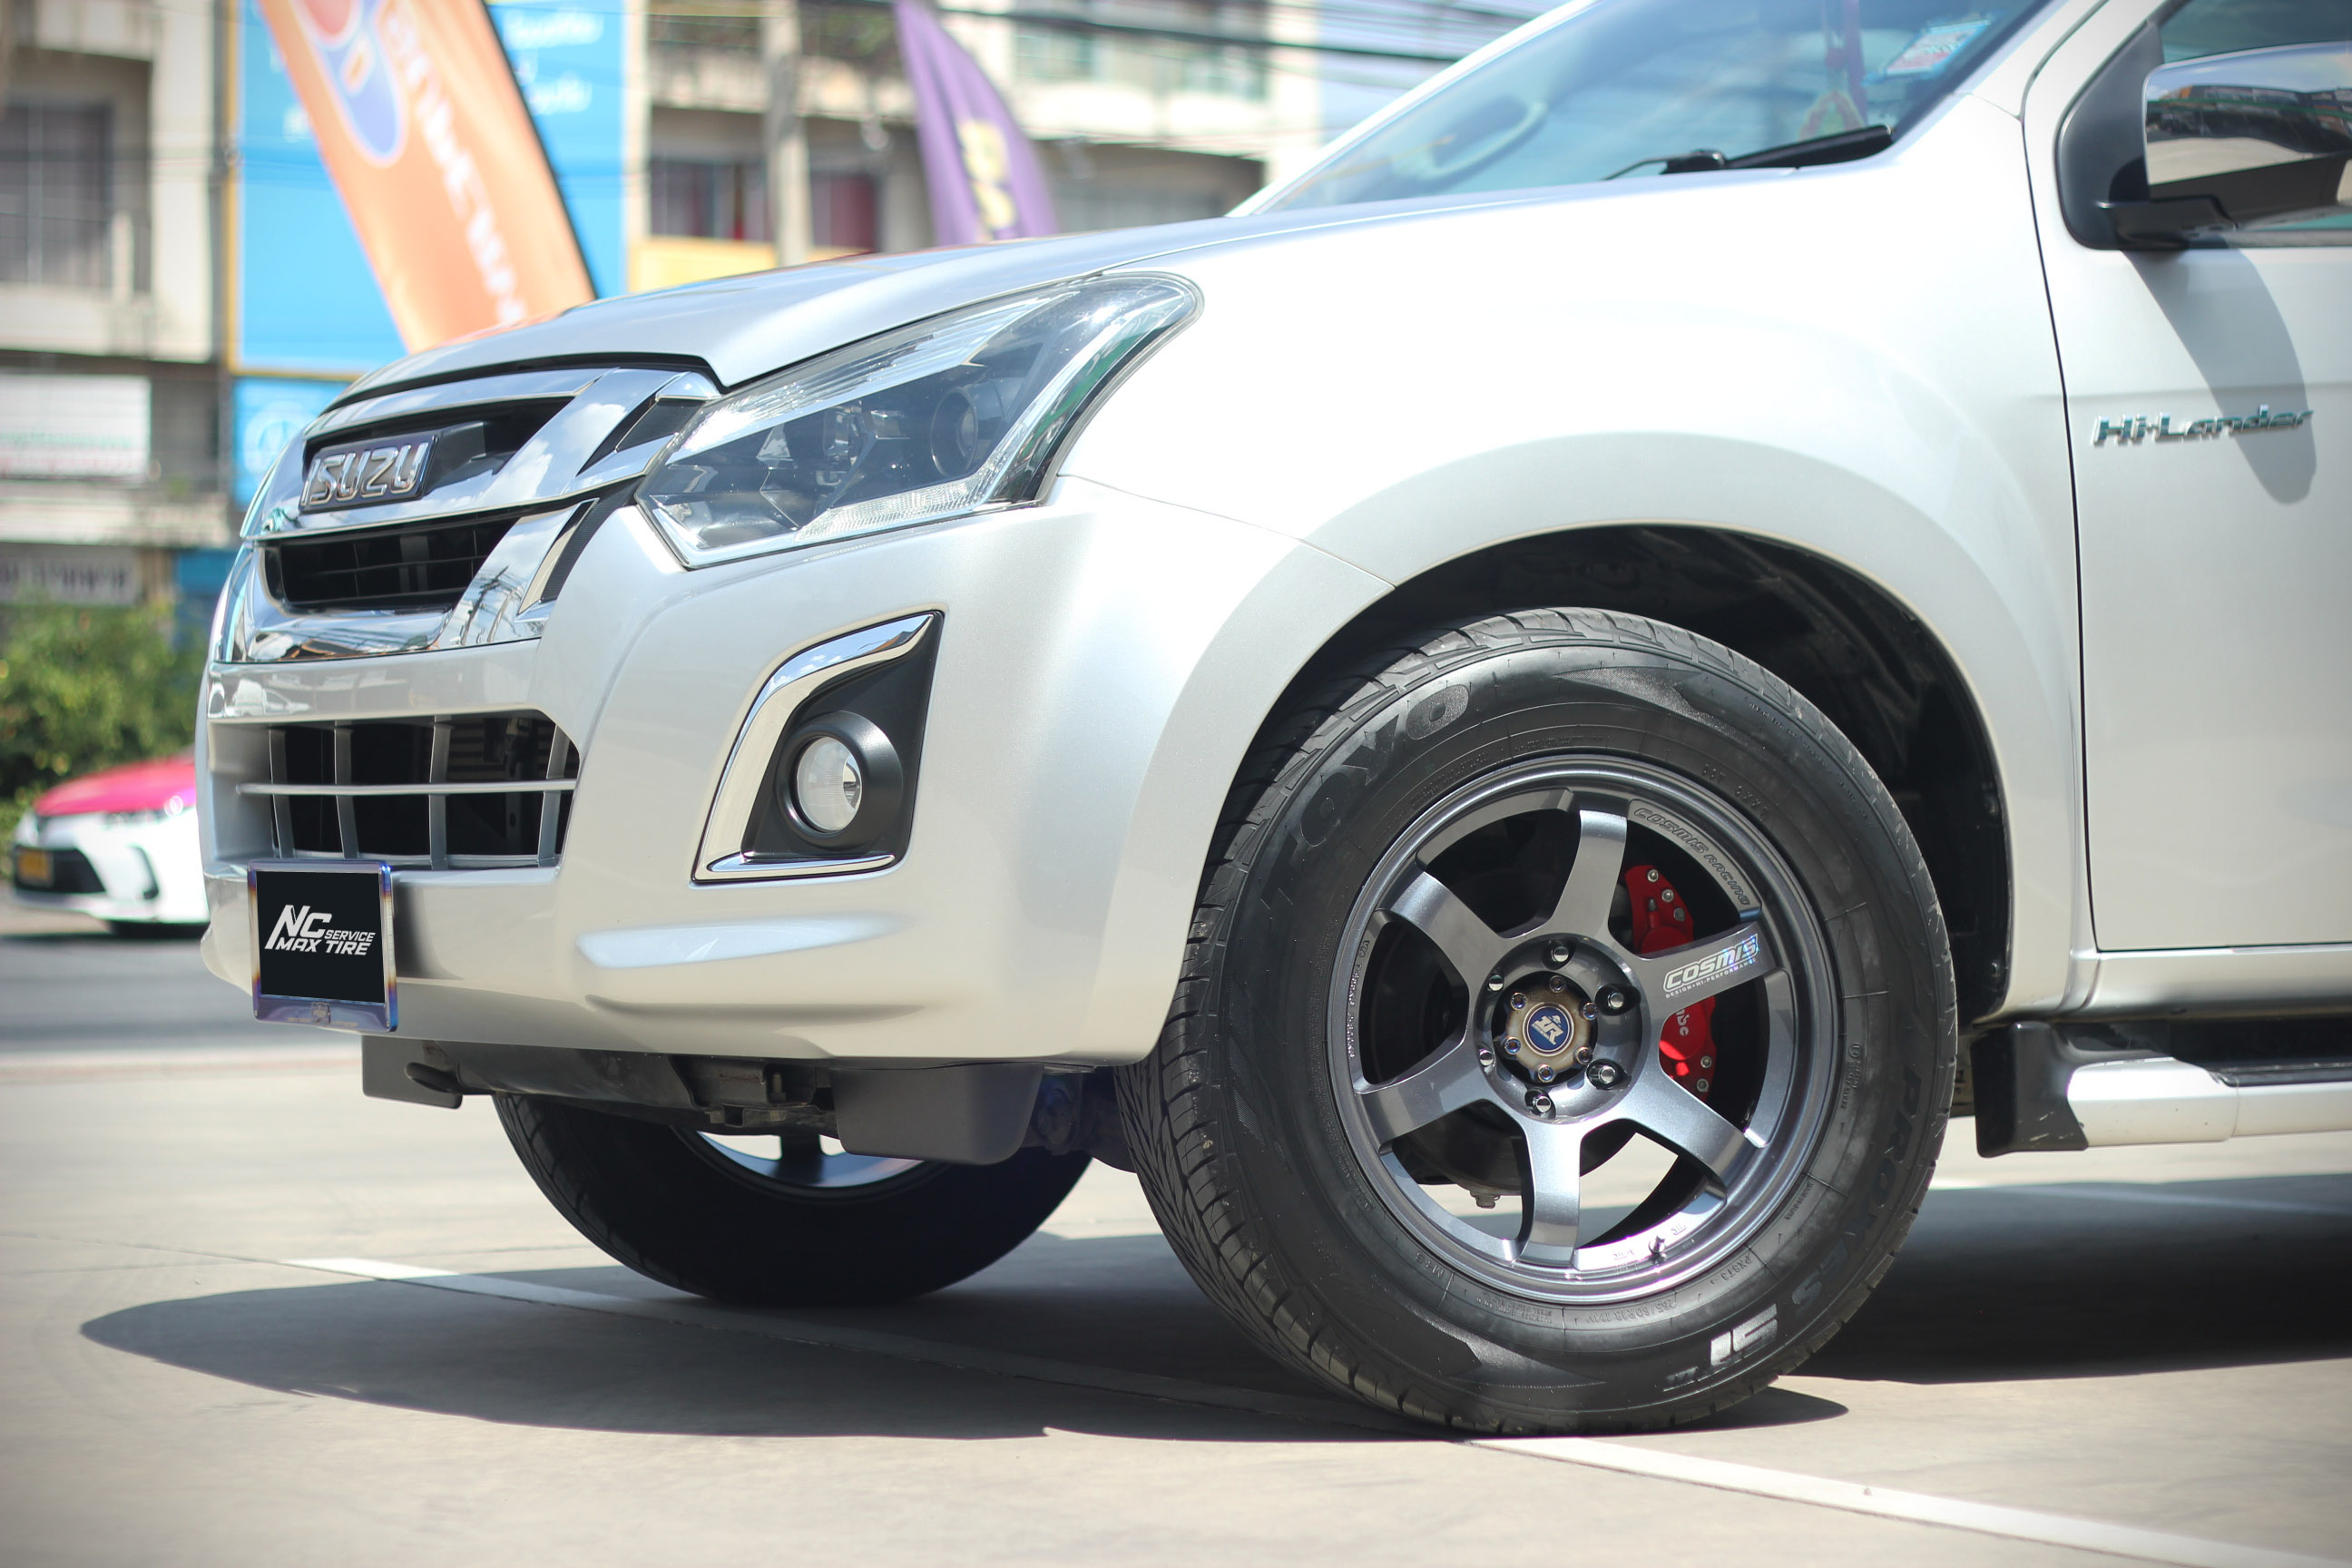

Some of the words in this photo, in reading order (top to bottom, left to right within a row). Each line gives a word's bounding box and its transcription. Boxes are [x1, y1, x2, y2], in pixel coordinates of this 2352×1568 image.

[2092, 405, 2315, 446] Hi-Lander
[301, 442, 429, 506] ISUZU
[1260, 683, 1469, 909] TOYO
[1634, 808, 1709, 854] COSMIS
[1703, 854, 1750, 906] RACING
[264, 904, 332, 950] NC
[324, 929, 376, 943] SERVICE
[275, 937, 321, 953] MAX
[326, 939, 371, 956] TIRE
[1665, 935, 1758, 990] COSMIS
